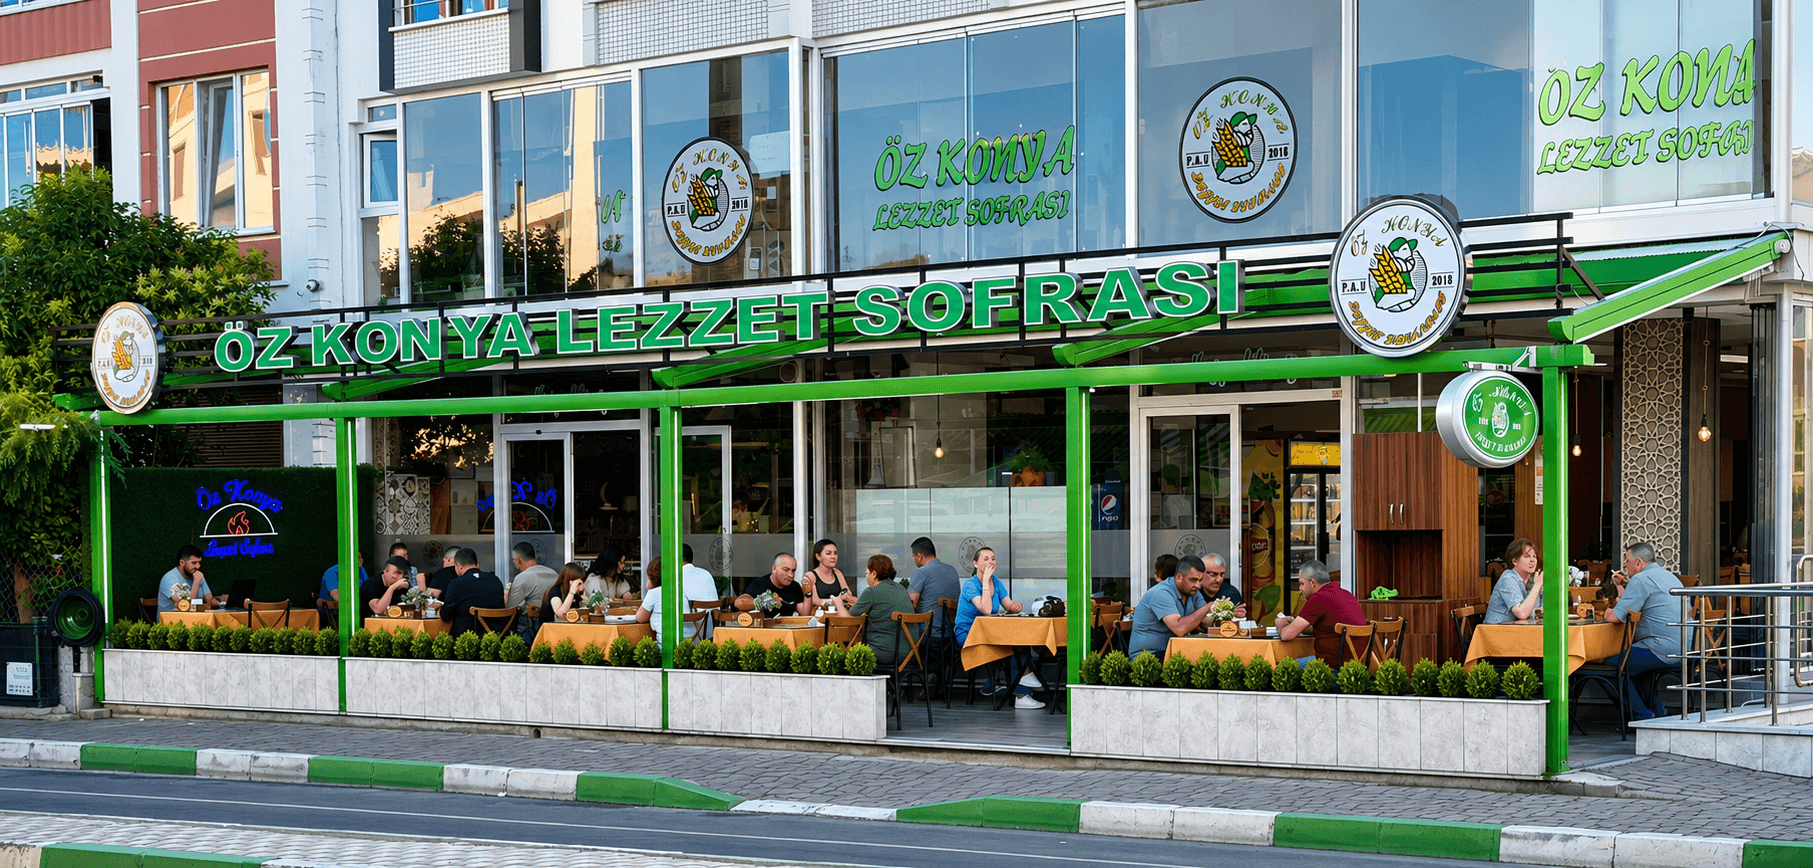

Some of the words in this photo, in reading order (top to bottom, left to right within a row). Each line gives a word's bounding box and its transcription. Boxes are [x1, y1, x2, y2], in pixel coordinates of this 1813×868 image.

[874, 135, 929, 191] ÖZ
[935, 125, 1075, 186] KONYA
[1537, 129, 1655, 175] LEZZET
[872, 197, 965, 231] LEZZET
[964, 190, 1071, 226] SOFRASI
[1341, 281, 1366, 294] P.A.U
[1432, 274, 1453, 286] 2018
[214, 320, 297, 373] ÖZ
[311, 312, 538, 367] KONYA
[556, 292, 830, 354] LEZZET
[853, 259, 1242, 336] SOFRASI
